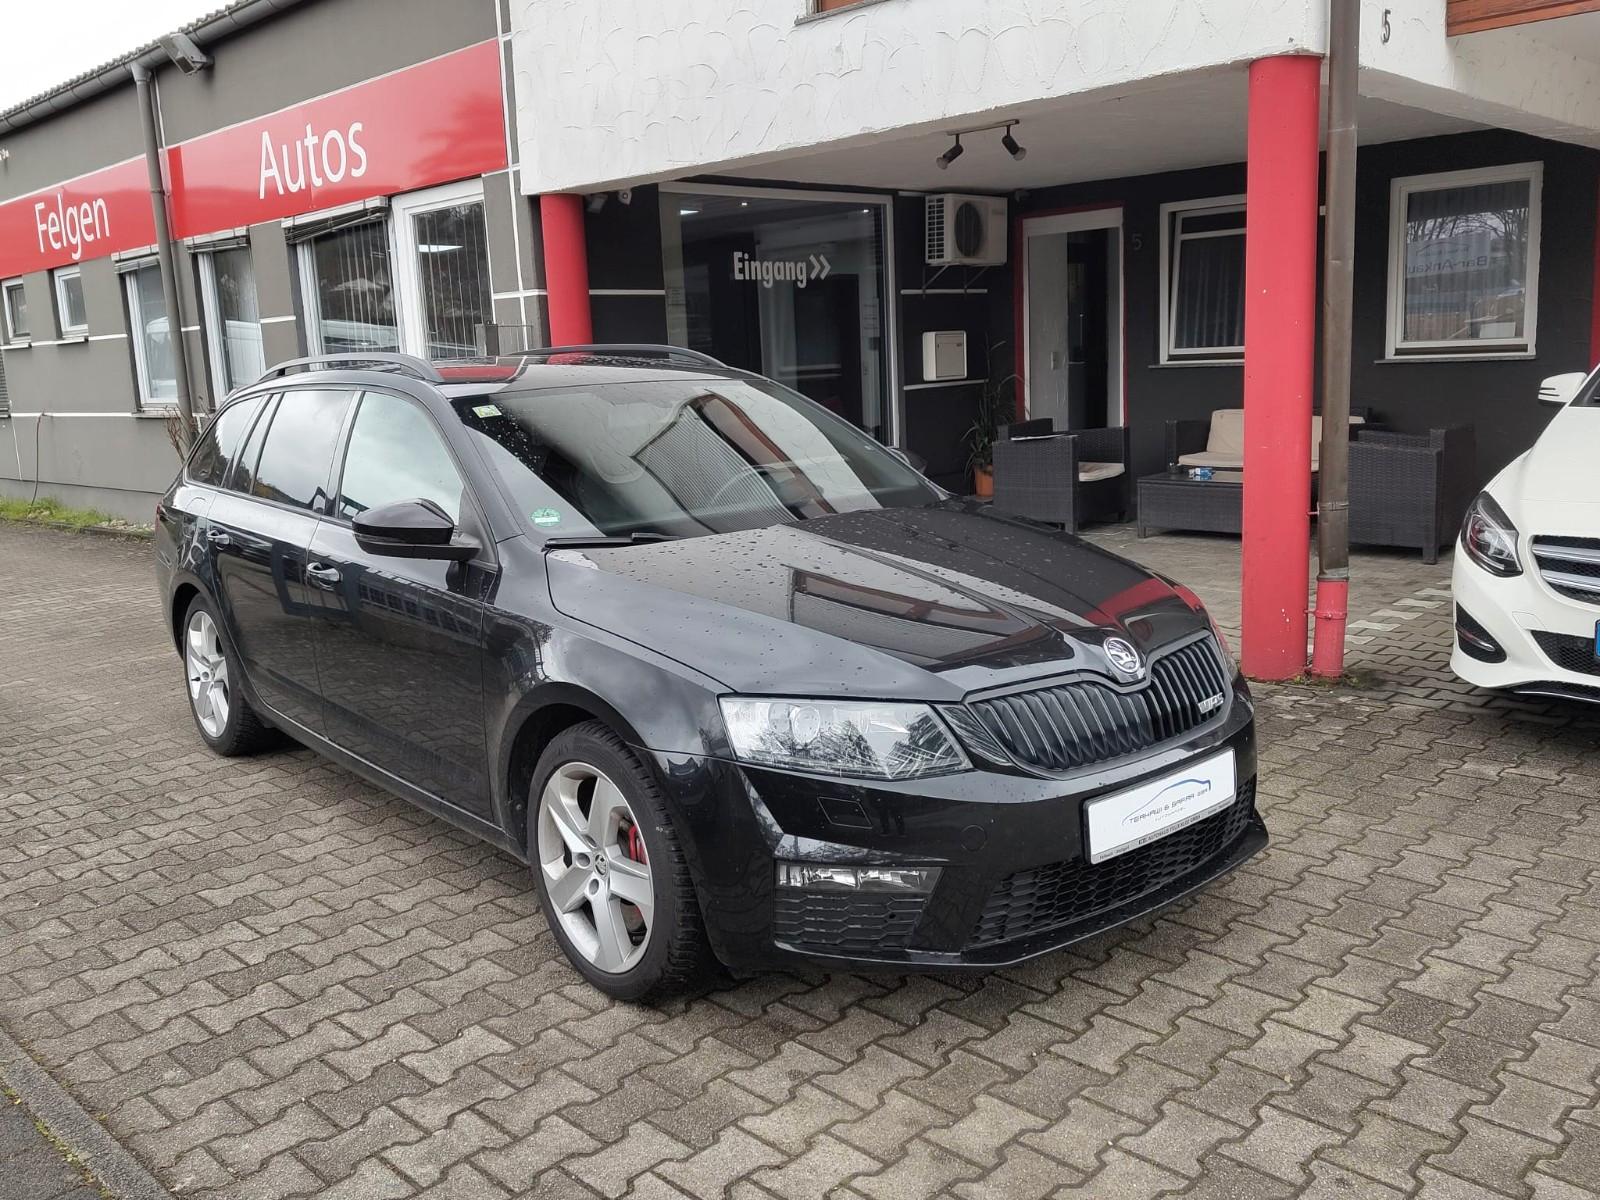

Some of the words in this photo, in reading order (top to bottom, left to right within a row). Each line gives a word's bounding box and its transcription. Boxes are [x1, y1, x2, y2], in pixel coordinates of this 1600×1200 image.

[1381, 8, 1391, 45] 5
[259, 121, 367, 200] Autos
[35, 193, 110, 260] Felgen
[1132, 233, 1142, 251] 5
[733, 251, 807, 288] Eingang
